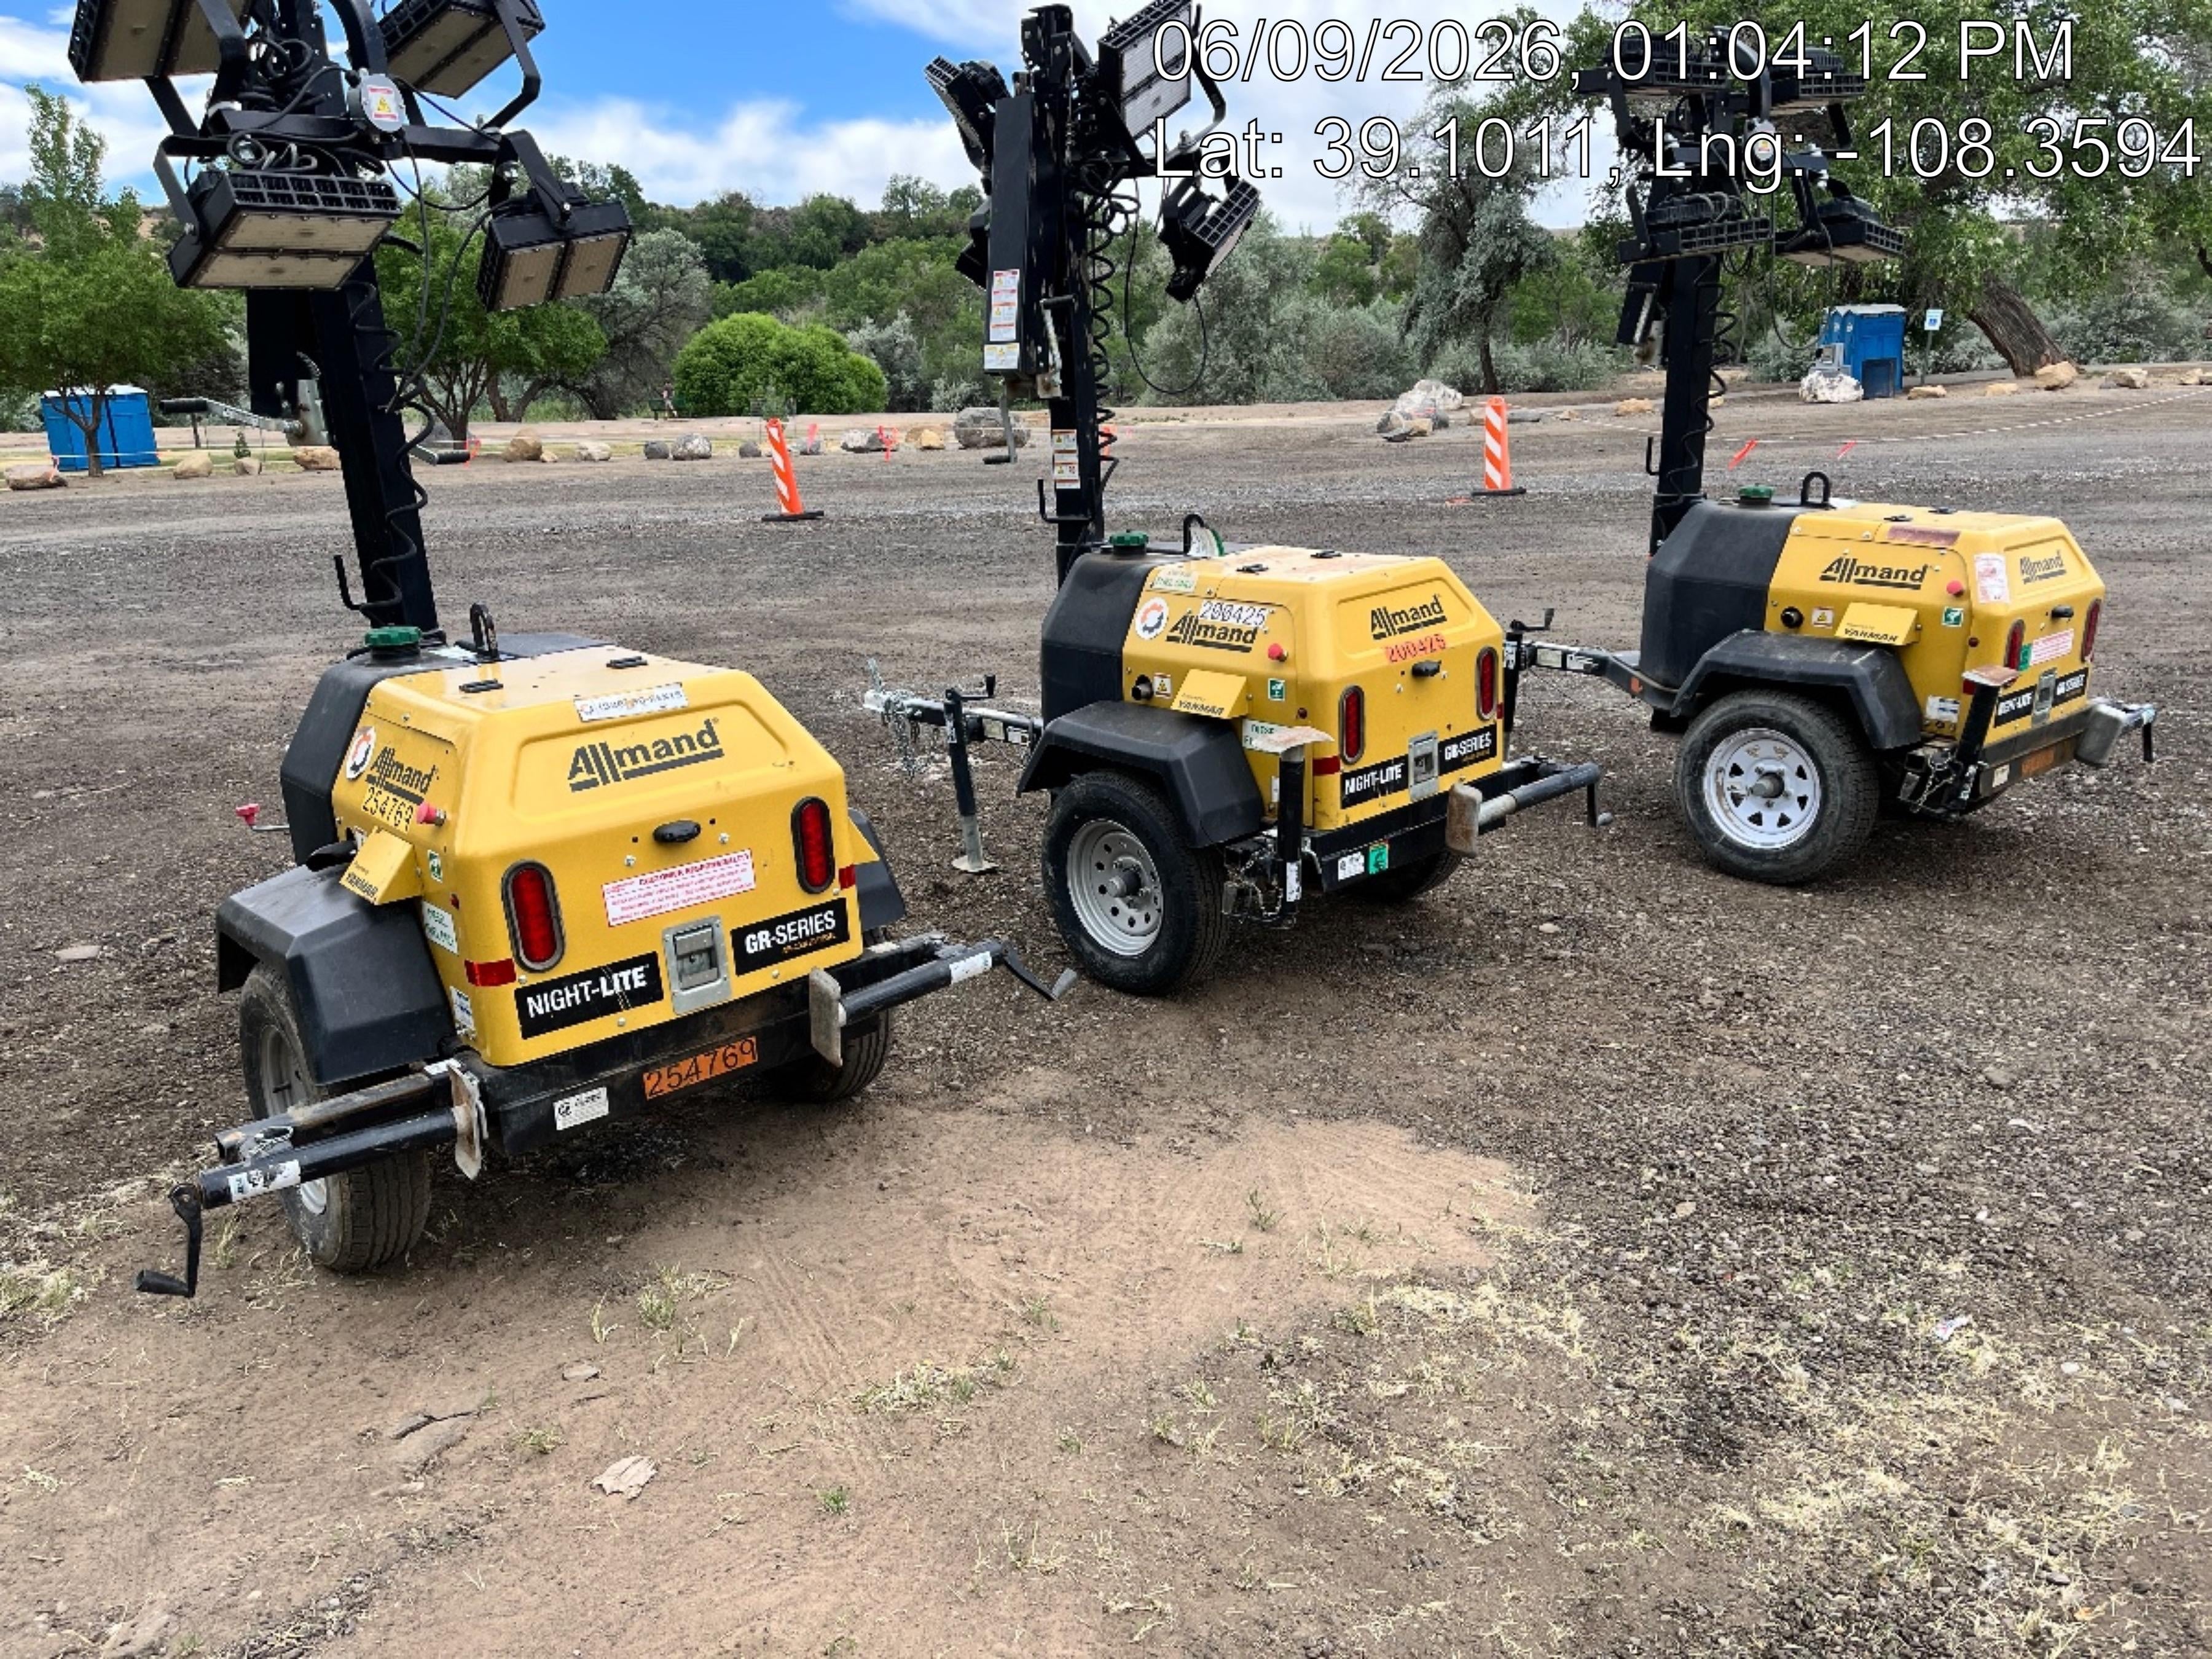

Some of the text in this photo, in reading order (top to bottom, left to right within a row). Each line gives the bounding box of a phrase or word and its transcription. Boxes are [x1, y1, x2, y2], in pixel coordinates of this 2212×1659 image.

[1822, 556, 1929, 584] Allmand
[1169, 612, 1258, 646] Allmand
[1200, 600, 1267, 626] 200425
[1371, 594, 1444, 637] Allmand
[369, 746, 436, 795] Allmand
[567, 718, 721, 786] Allmand
[1344, 763, 1403, 796] NIGHT-LITE
[363, 786, 414, 832] 254769
[745, 910, 837, 955] GR-SERIES
[526, 965, 648, 1019] NIGHT-LITE
[646, 1038, 758, 1096] 254769
